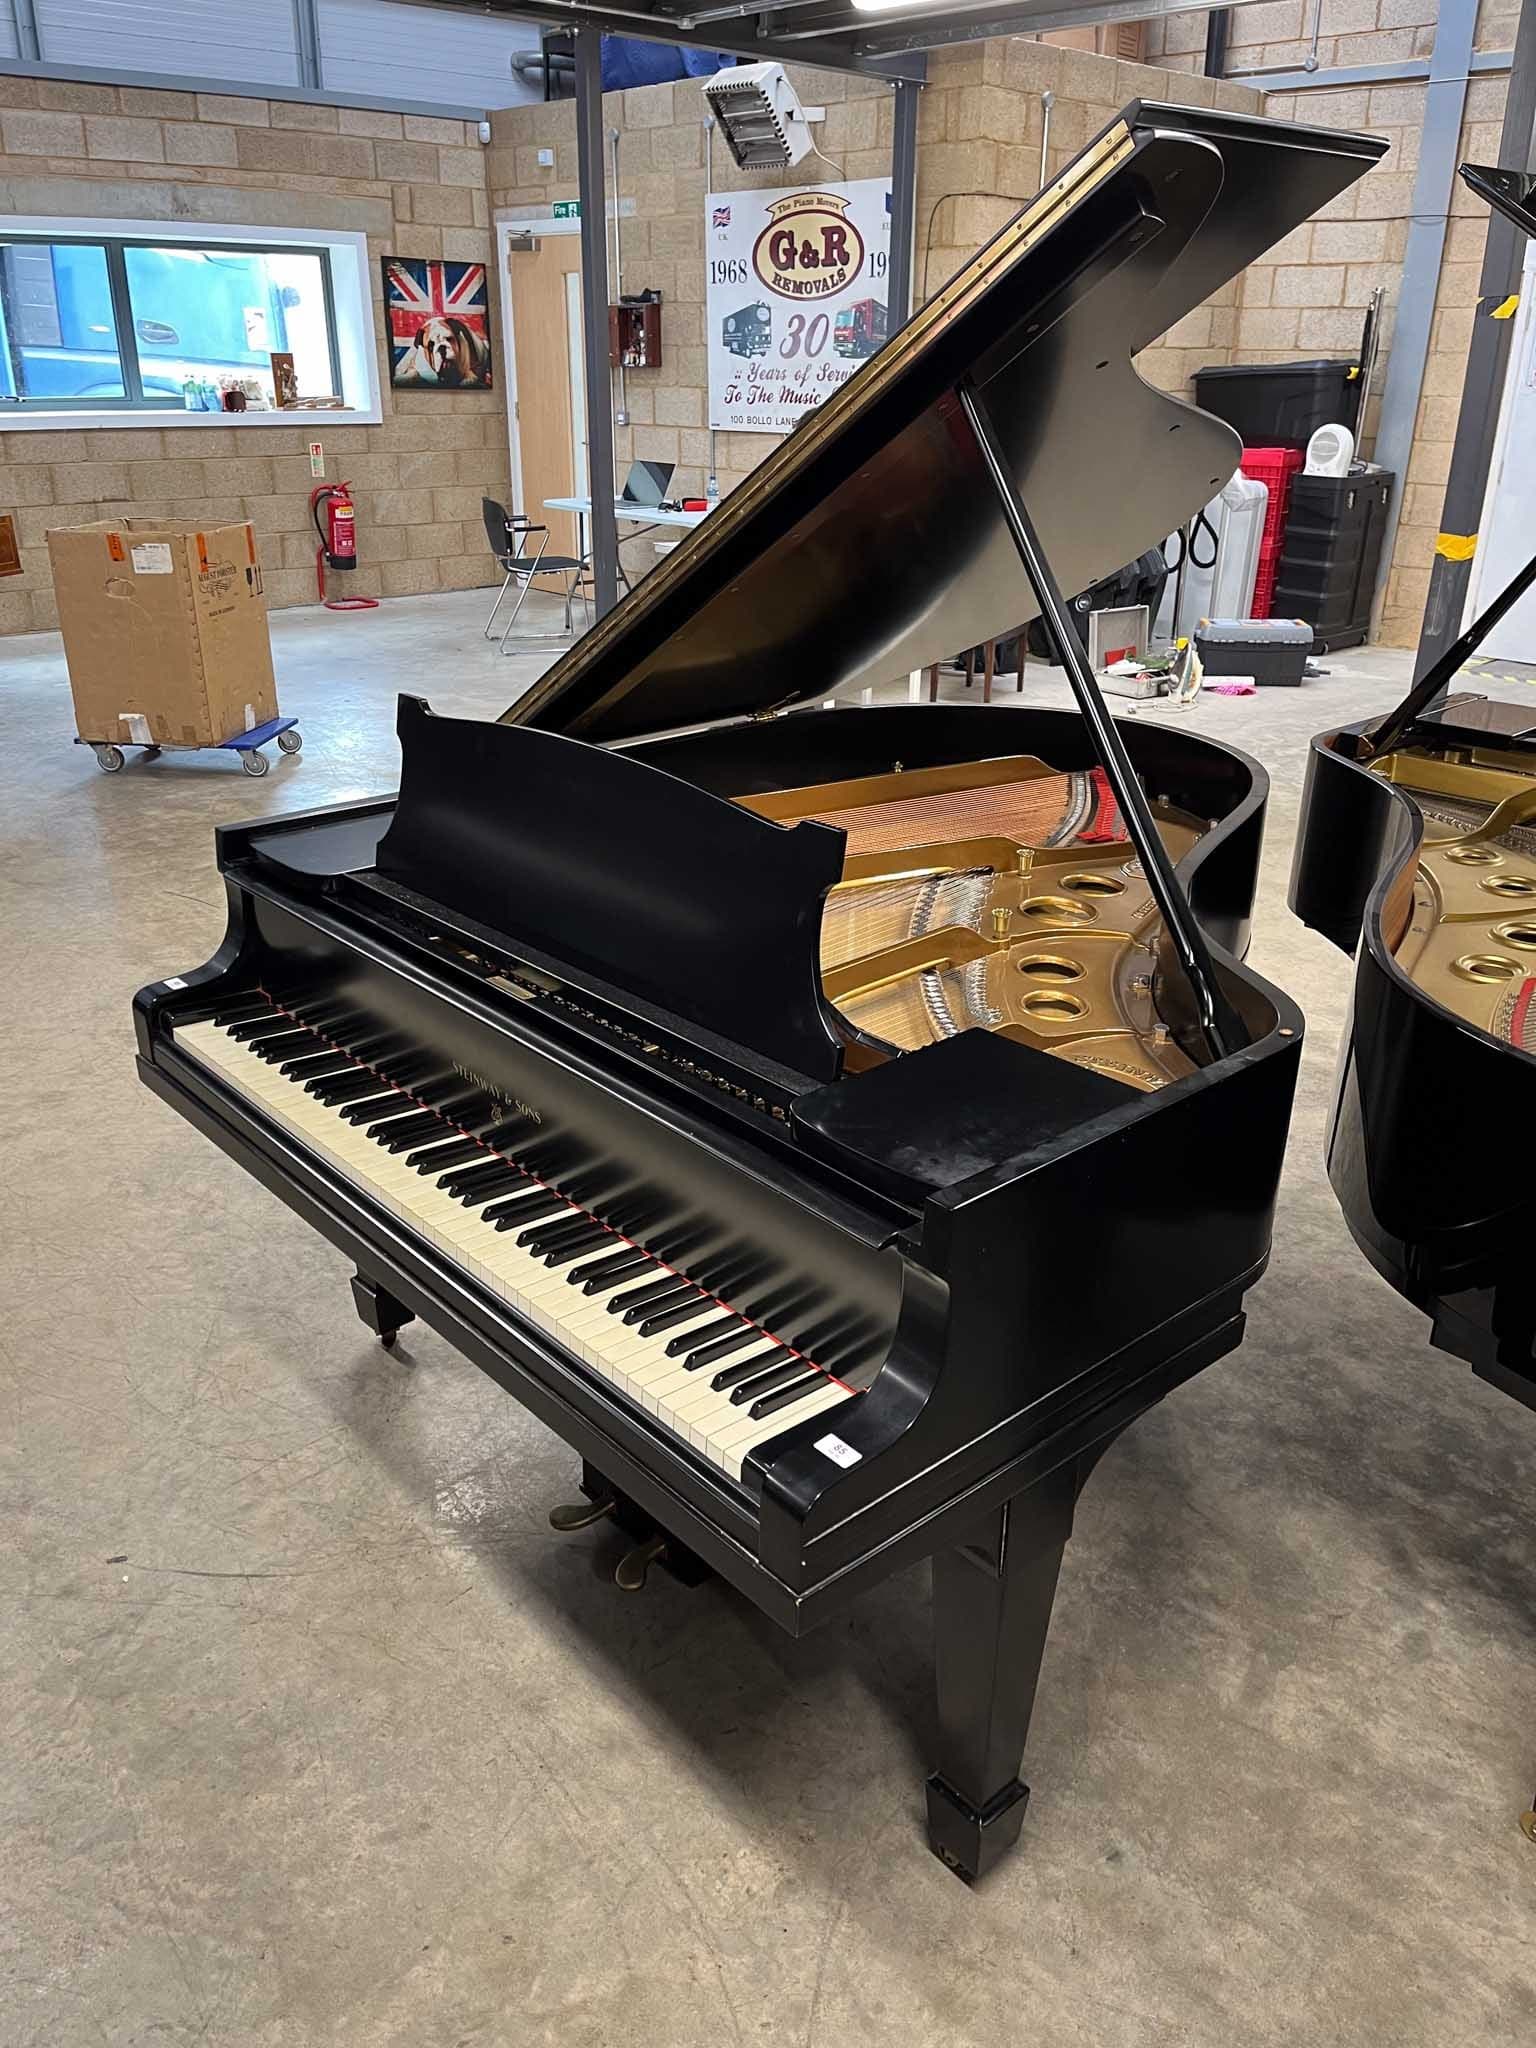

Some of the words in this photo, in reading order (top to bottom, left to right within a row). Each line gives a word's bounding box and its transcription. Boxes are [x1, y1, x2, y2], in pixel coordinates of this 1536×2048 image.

[554, 205, 567, 215] Fire
[769, 225, 850, 271] G&R
[710, 258, 748, 285] 1968
[771, 267, 847, 295] REMOVALS
[779, 313, 830, 360] 30
[747, 362, 788, 383] Years
[793, 362, 812, 388] of
[724, 384, 743, 405] To
[747, 384, 774, 405] The
[778, 385, 822, 405] Music
[730, 415, 744, 424] 100
[746, 416, 772, 425] BOLLO
[775, 416, 797, 426] LANE
[515, 1098, 543, 1125] SONS
